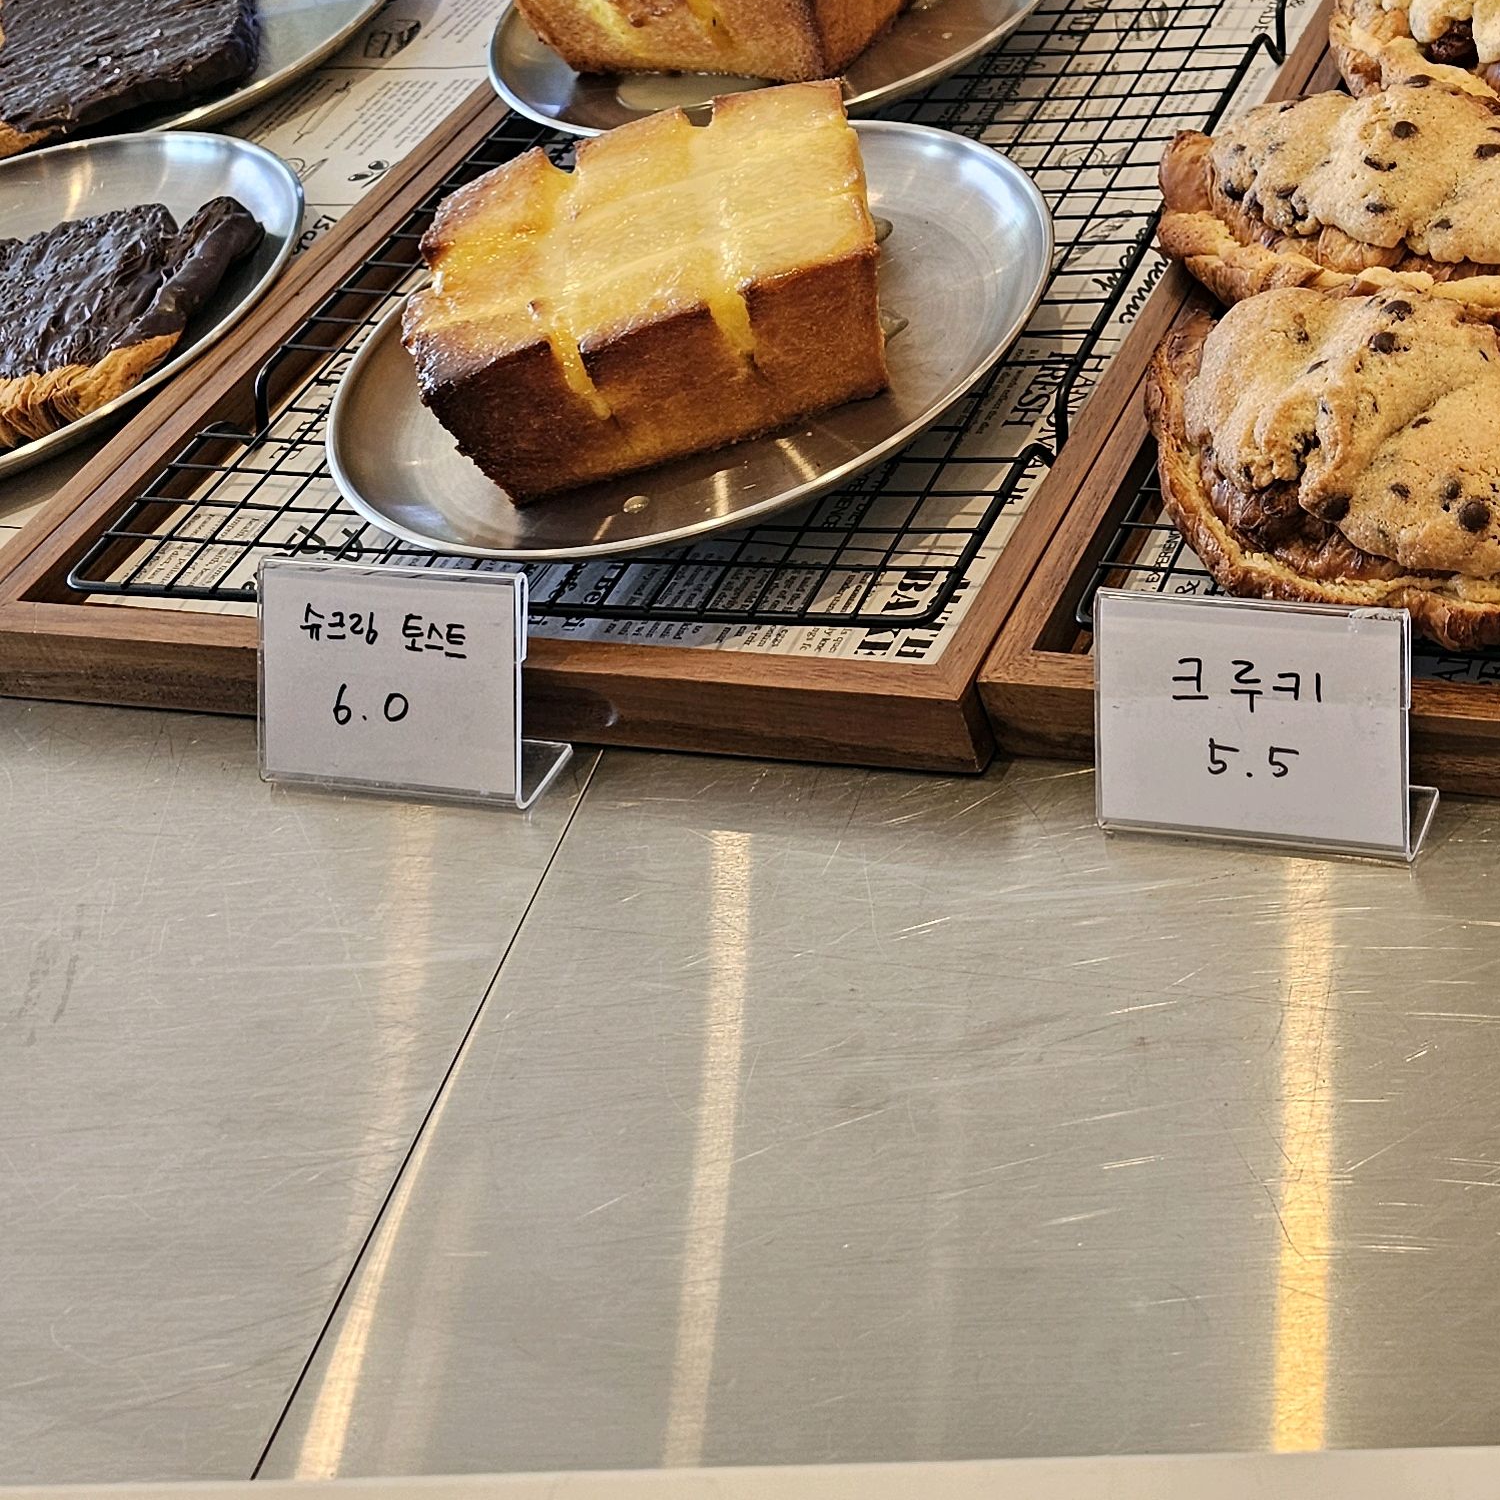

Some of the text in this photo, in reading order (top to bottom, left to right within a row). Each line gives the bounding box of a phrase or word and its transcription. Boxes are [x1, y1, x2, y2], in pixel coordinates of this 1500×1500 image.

[402, 613, 467, 659] 토스트
[332, 682, 410, 726] 6.0
[1172, 657, 1323, 713] 크루키
[1207, 737, 1300, 779] 5.5
